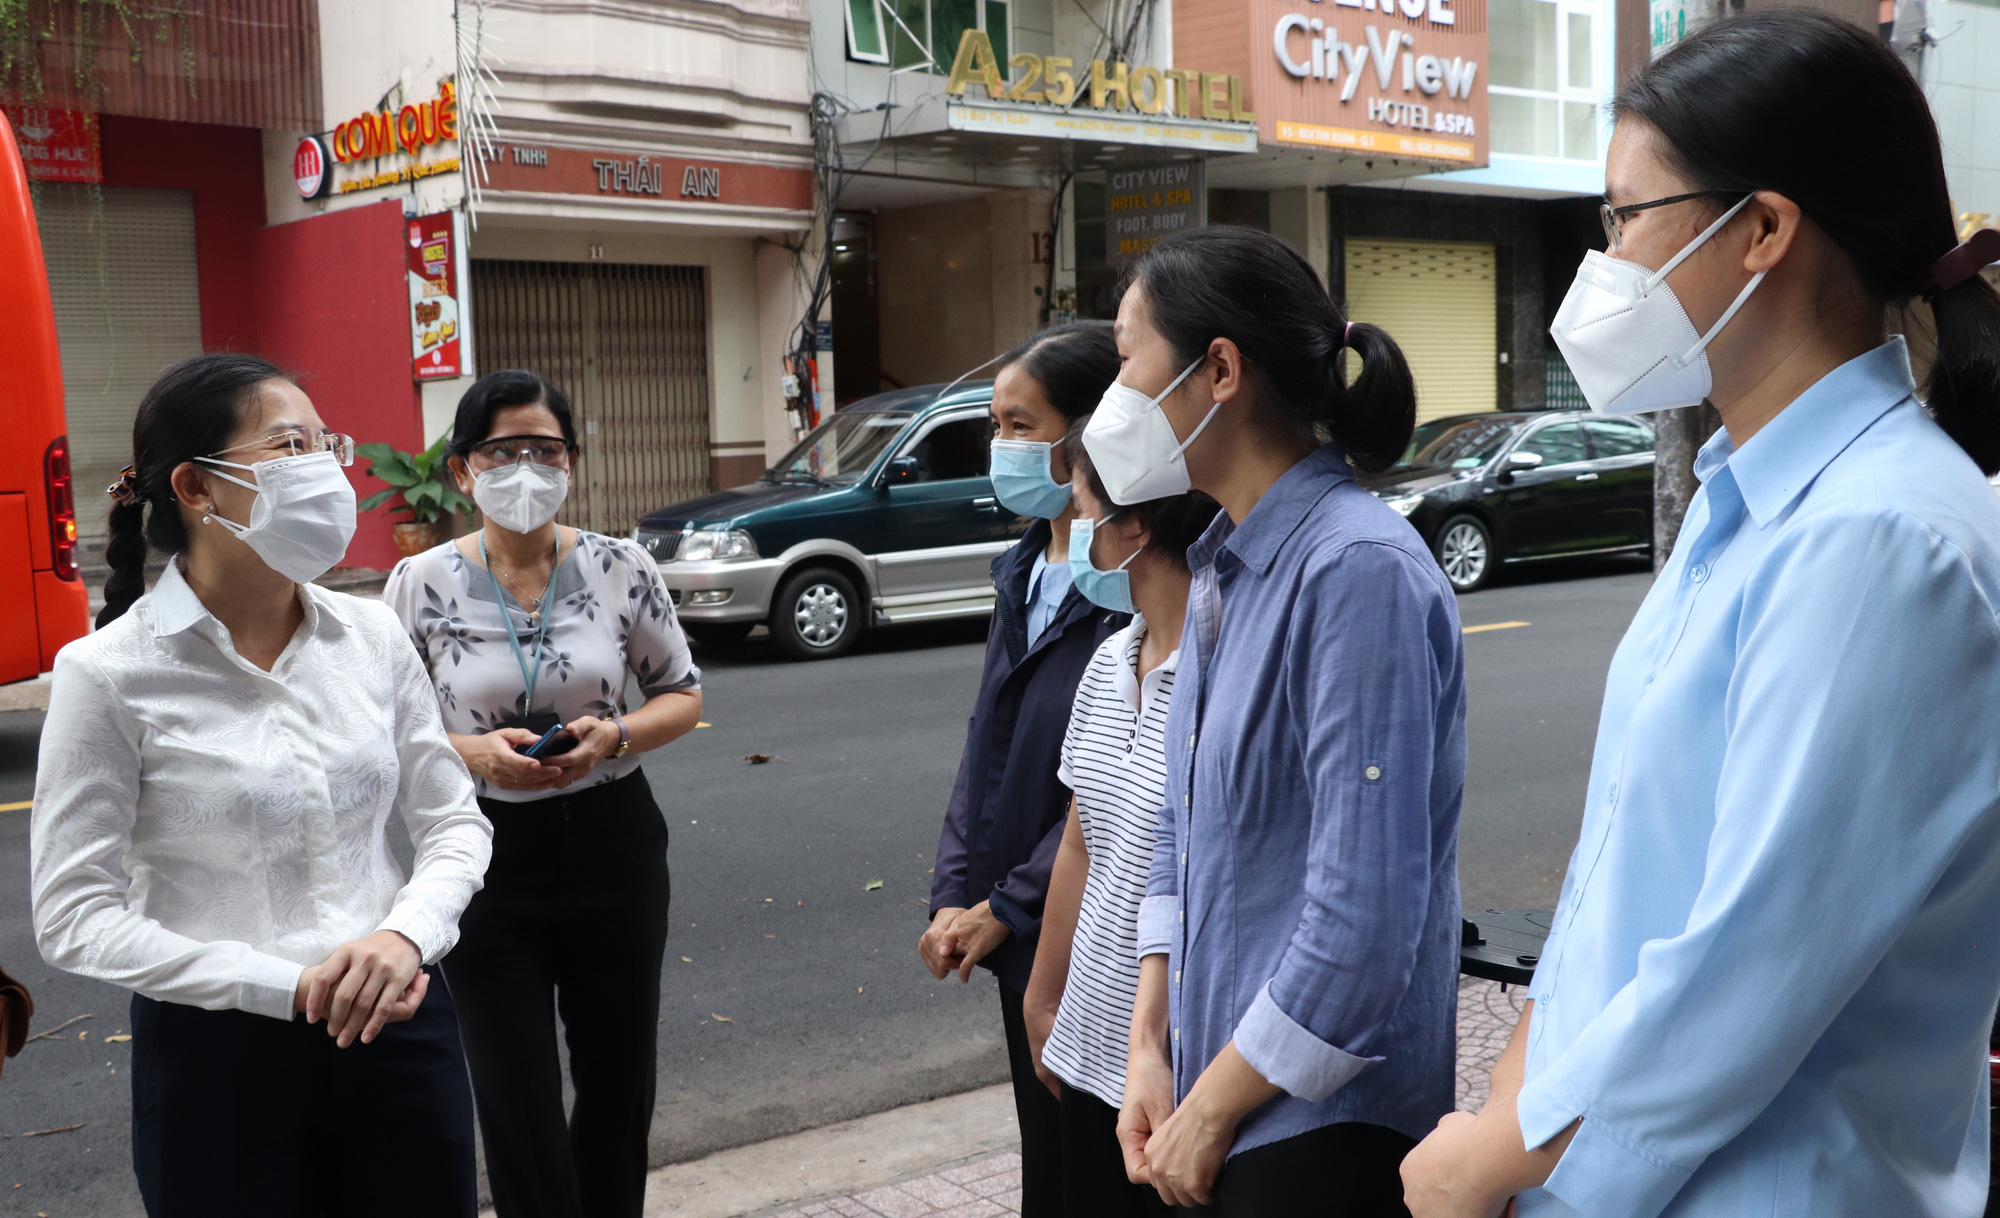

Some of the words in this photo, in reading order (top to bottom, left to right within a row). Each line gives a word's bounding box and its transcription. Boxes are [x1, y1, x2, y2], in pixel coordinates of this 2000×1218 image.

[1274, 13, 1477, 101] CityView
[946, 28, 1075, 105] A25
[1090, 59, 1256, 121] HOTEL
[398, 83, 457, 155] QUÊ
[1369, 97, 1432, 130] HOTEL
[512, 147, 547, 166] TNHH
[681, 165, 719, 198] AN
[1113, 171, 1145, 189] CITY
[1149, 166, 1189, 186] VIEW
[1111, 193, 1148, 211] HOTEL
[1153, 192, 1163, 207] &
[1167, 189, 1191, 205] SPA
[1117, 216, 1150, 233] FOOT,
[1153, 212, 1185, 229] BODY
[423, 279, 448, 297] BEER
